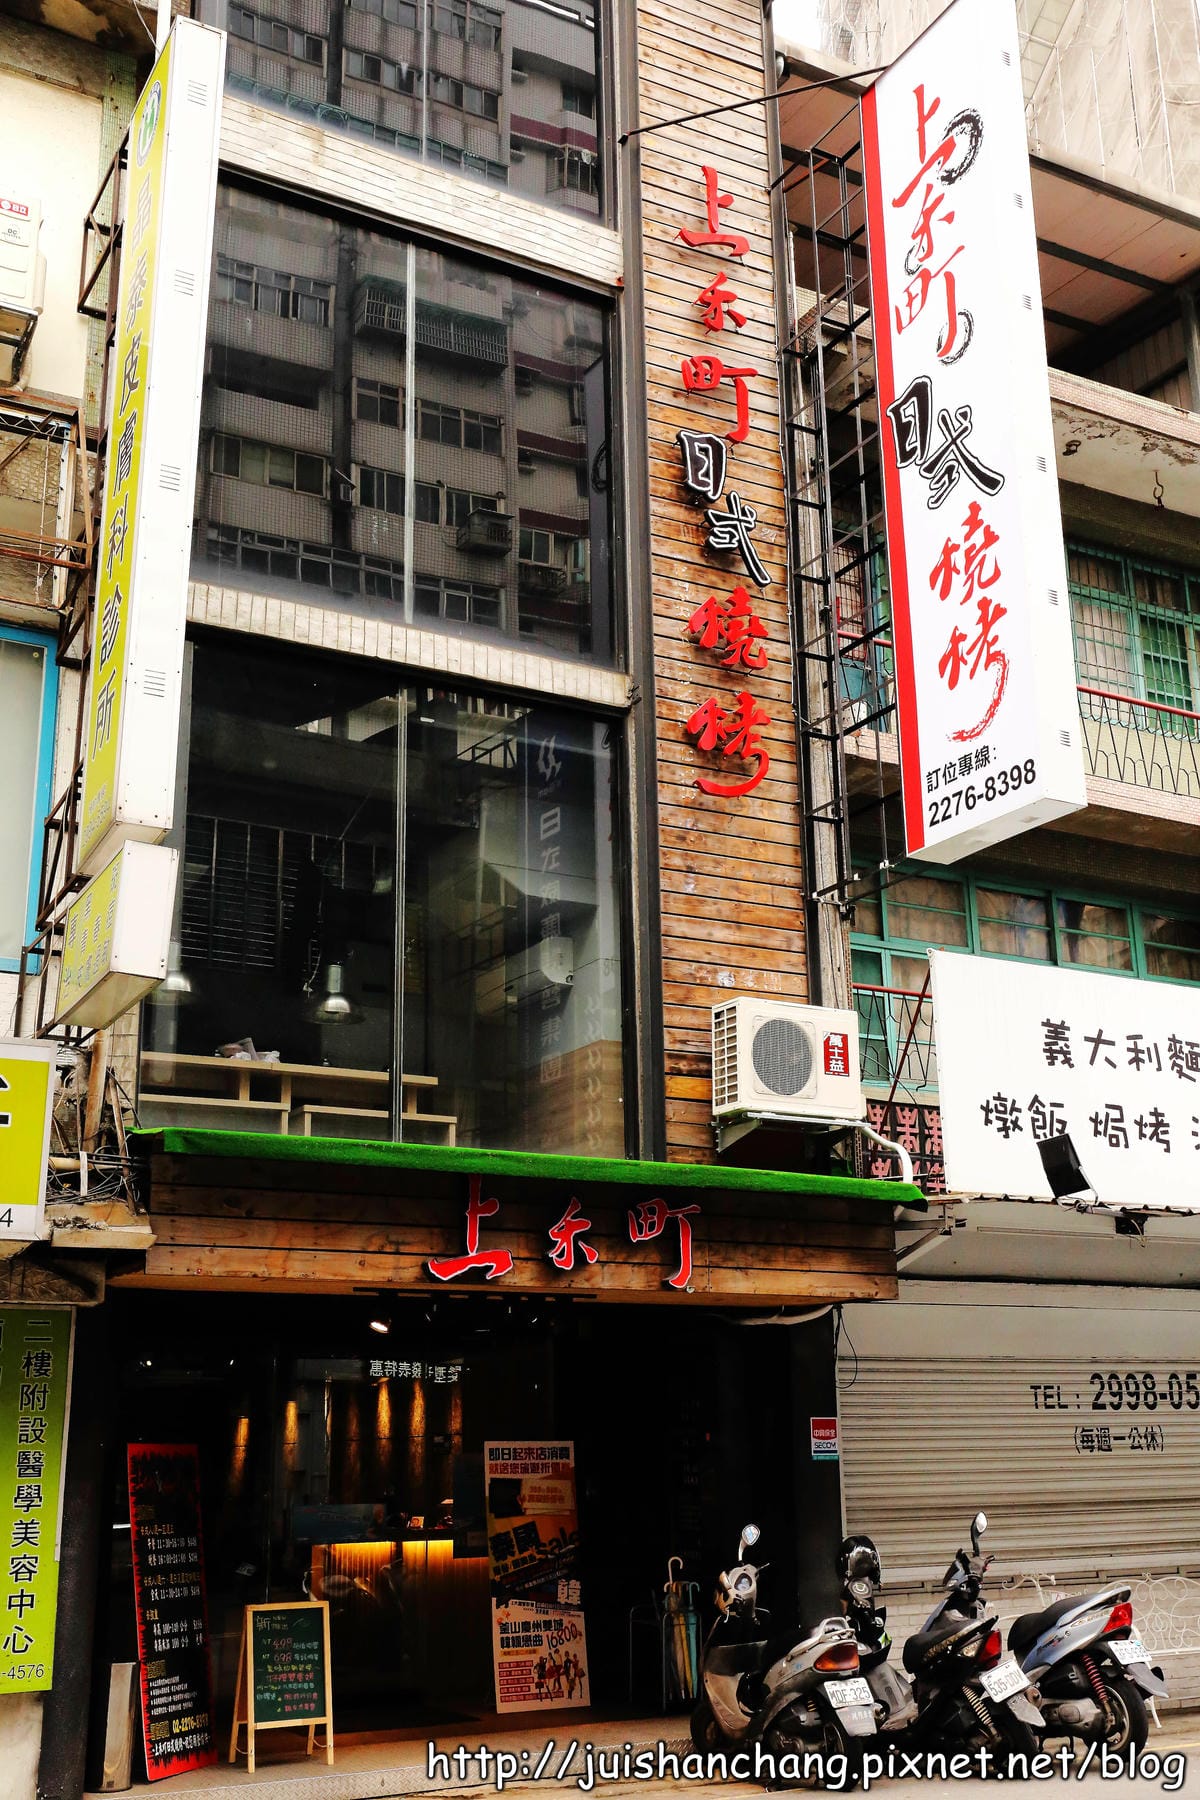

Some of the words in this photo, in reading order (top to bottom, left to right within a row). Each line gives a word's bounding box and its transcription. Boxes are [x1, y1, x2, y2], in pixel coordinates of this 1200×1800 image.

[92, 174, 151, 761] 晶泰皮膚科診所
[928, 759, 1036, 827] 2276-8398
[828, 1034, 845, 1073] 萬士益
[1041, 1018, 1200, 1082] 義大利麵
[428, 1173, 701, 1288] 上禾町
[3, 1319, 52, 1655] 二樓附設醫學美容中心
[489, 1447, 570, 1460] 即日起來店消費
